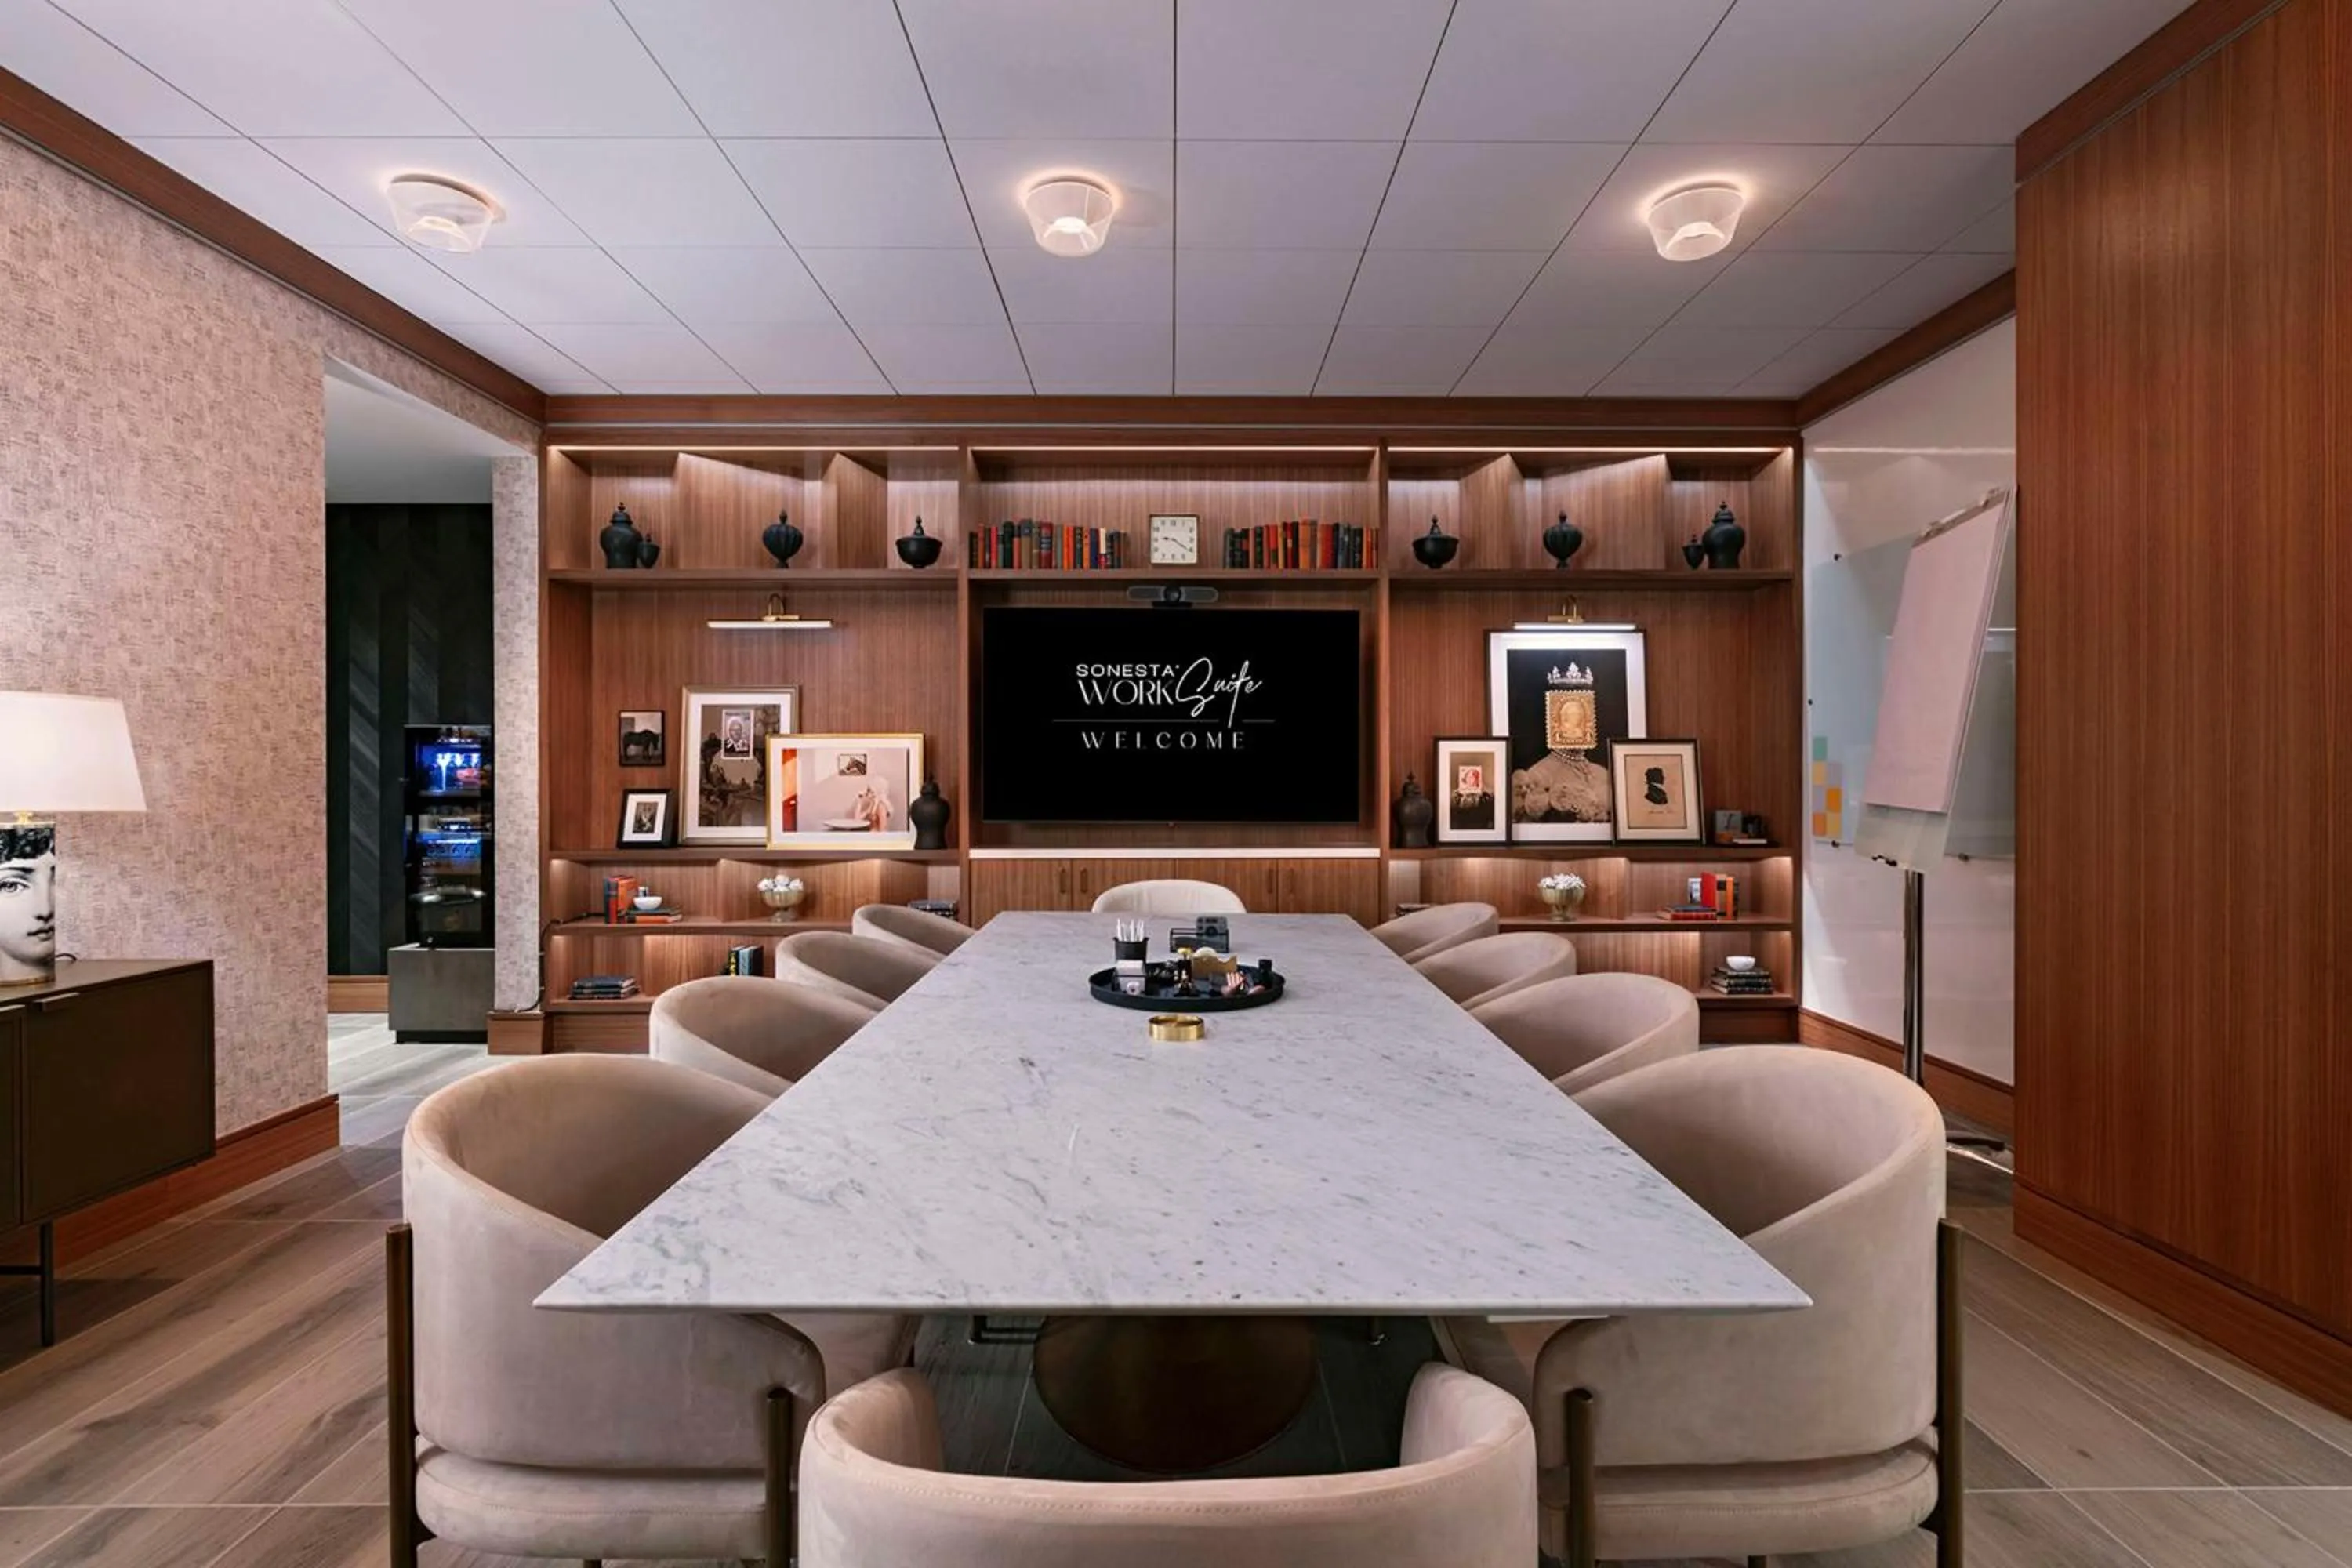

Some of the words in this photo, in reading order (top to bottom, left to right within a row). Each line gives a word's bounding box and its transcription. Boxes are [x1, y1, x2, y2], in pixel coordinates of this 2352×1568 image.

[1076, 664, 1175, 677] SONESTA
[1077, 679, 1174, 705] WORK
[1176, 657, 1263, 728] Suite
[1081, 731, 1244, 750] WELCOME
